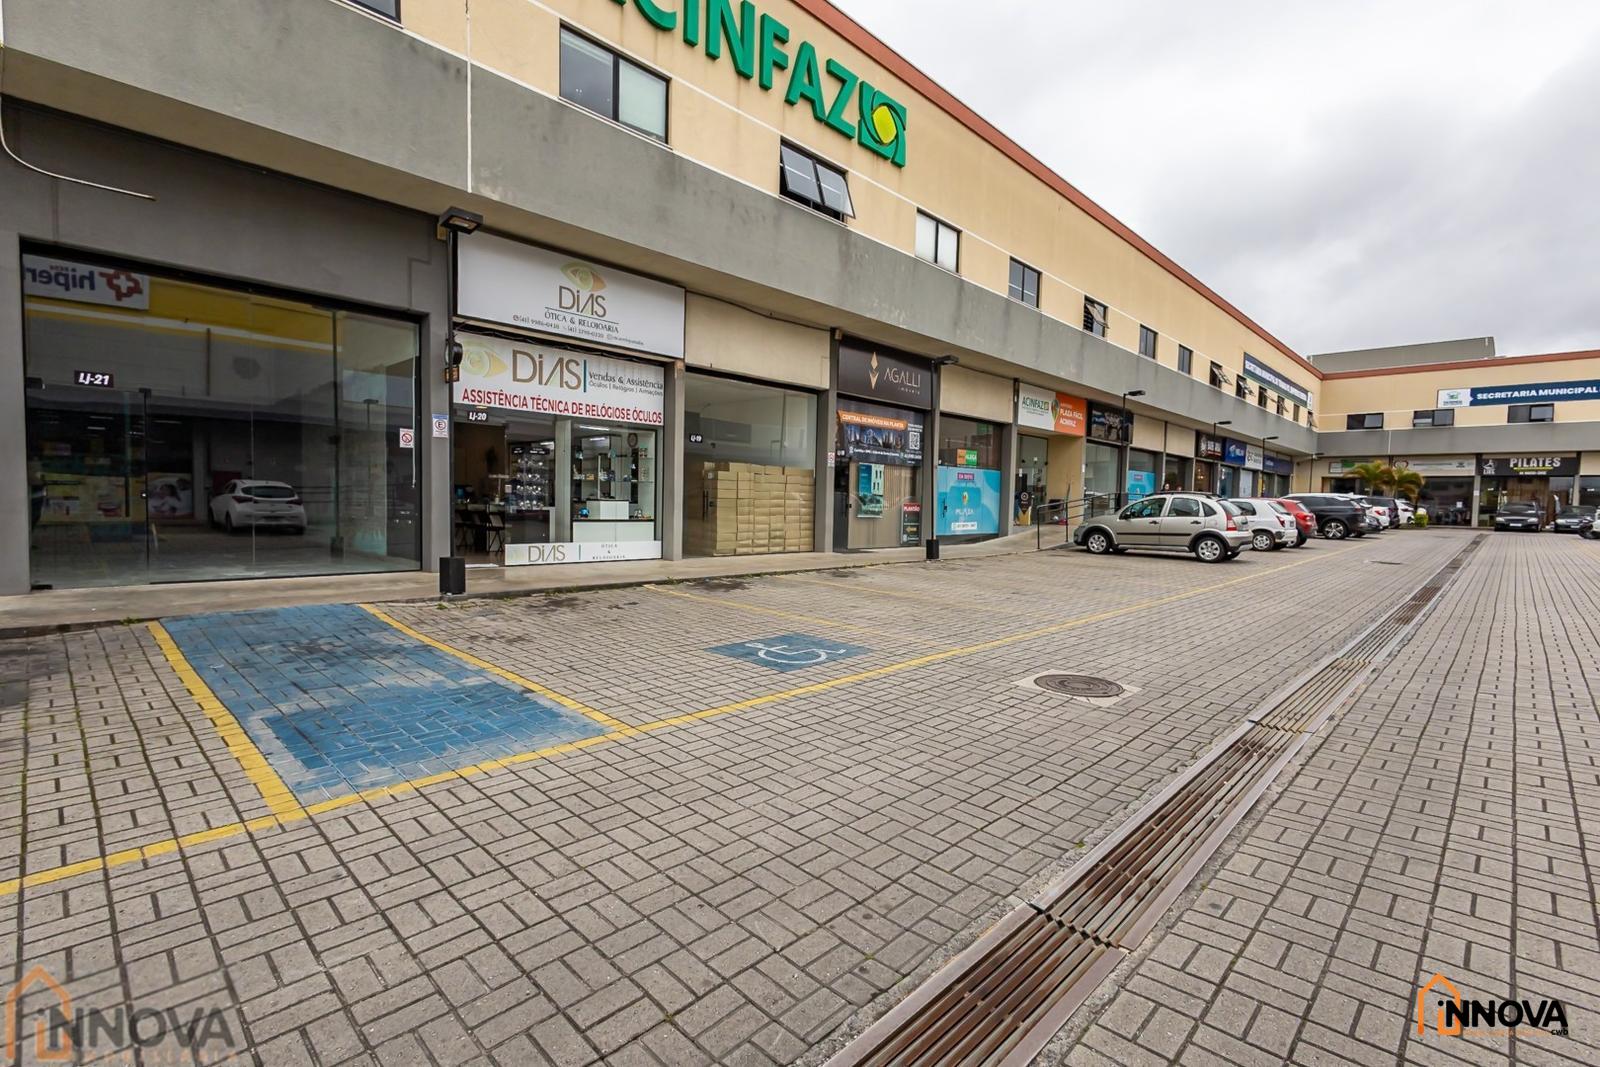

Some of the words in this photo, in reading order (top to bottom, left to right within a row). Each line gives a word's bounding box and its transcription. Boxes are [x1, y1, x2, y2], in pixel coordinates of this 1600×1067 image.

[544, 309, 567, 323] ÓTICA
[569, 317, 576, 325] &
[589, 371, 616, 383] Vendas
[626, 378, 663, 390] Assistência
[884, 367, 921, 388] AGALLI
[1476, 391, 1538, 400] SECRETARIA
[1538, 386, 1599, 397] MUNICIPAL
[462, 388, 528, 409] ASSISTÊNCIA
[530, 394, 570, 414] TÉCNICA
[571, 402, 583, 415] DE
[632, 406, 662, 424] ÓCULOS
[1022, 396, 1044, 410] ACINFAZ
[1509, 457, 1561, 468] PILATES
